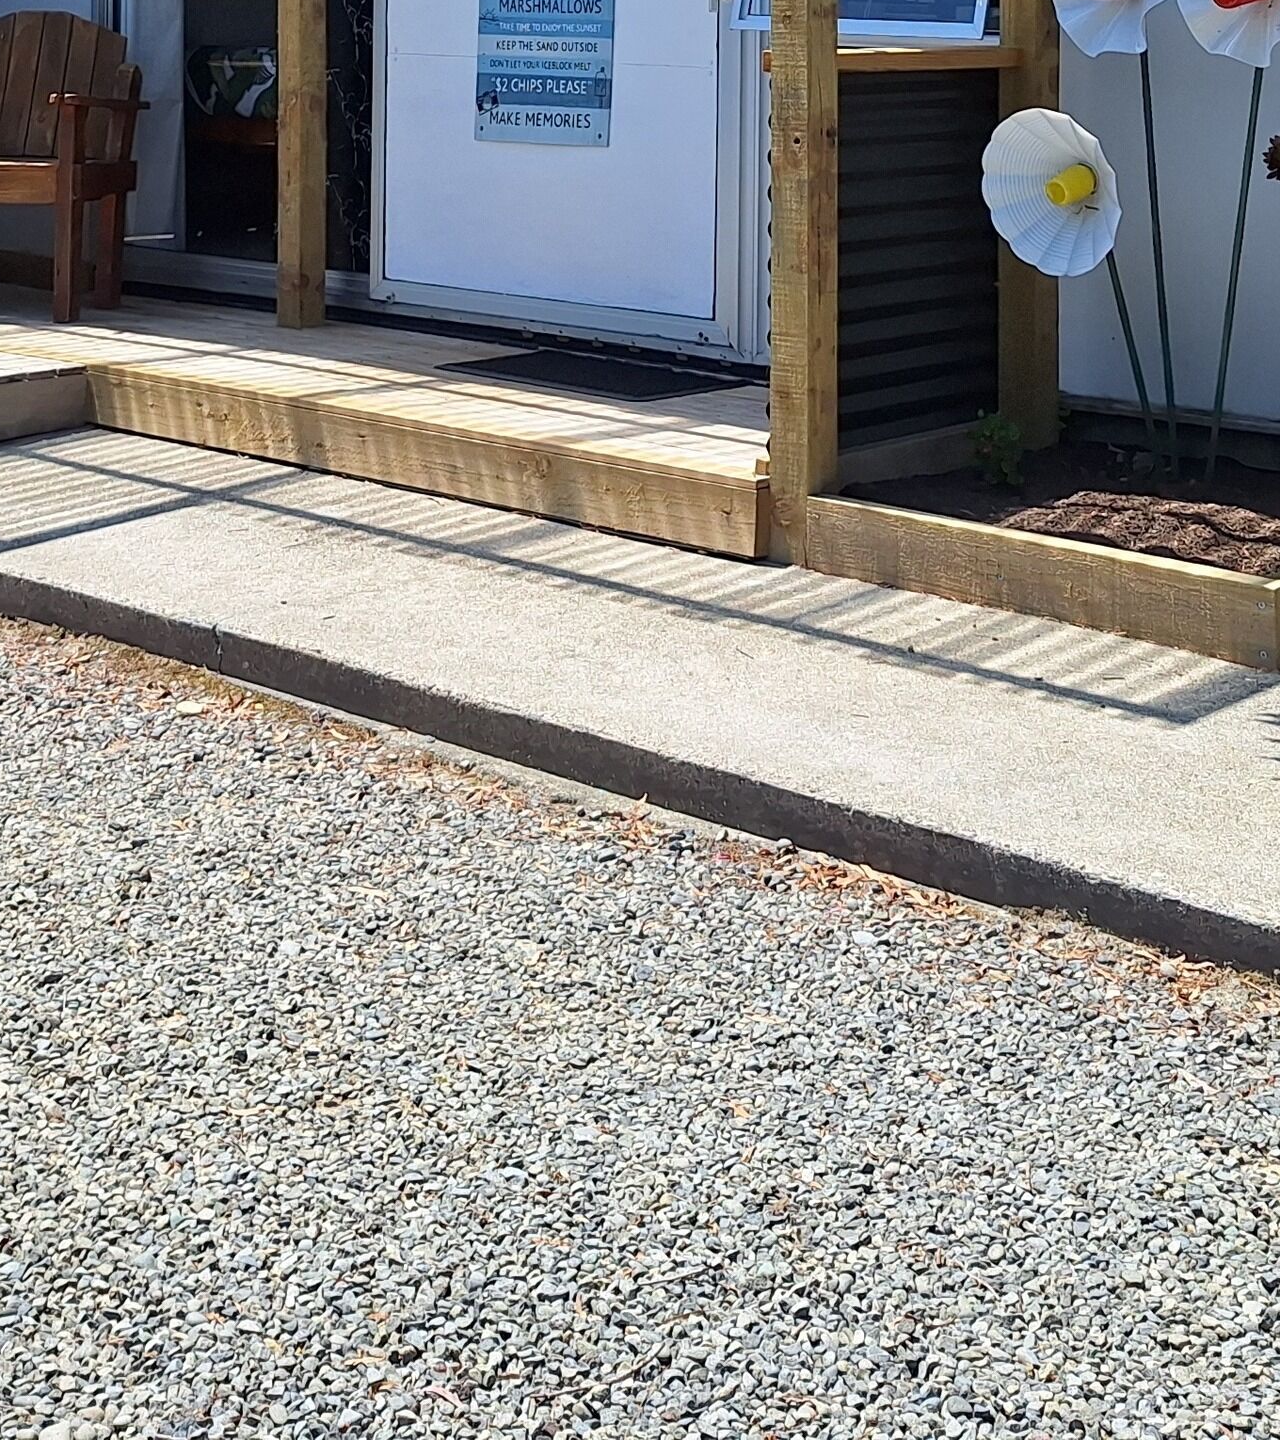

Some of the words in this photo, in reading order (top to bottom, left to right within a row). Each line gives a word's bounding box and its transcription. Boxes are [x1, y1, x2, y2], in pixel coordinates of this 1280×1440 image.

[499, 22, 514, 32] TAKE
[516, 22, 530, 32] TIME
[532, 23, 540, 32] TO
[541, 23, 561, 33] ENJOY
[563, 23, 575, 33] THE
[576, 23, 602, 33] SUNSET
[496, 40, 517, 51] KEEP
[519, 40, 534, 51] THE
[536, 41, 559, 52] SAND
[561, 42, 598, 53] OUTSIDE
[574, 62, 592, 71] MELT
[511, 78, 543, 93] CHIPS
[489, 110, 521, 126] MAKE
[525, 112, 592, 129] MEMORIES
